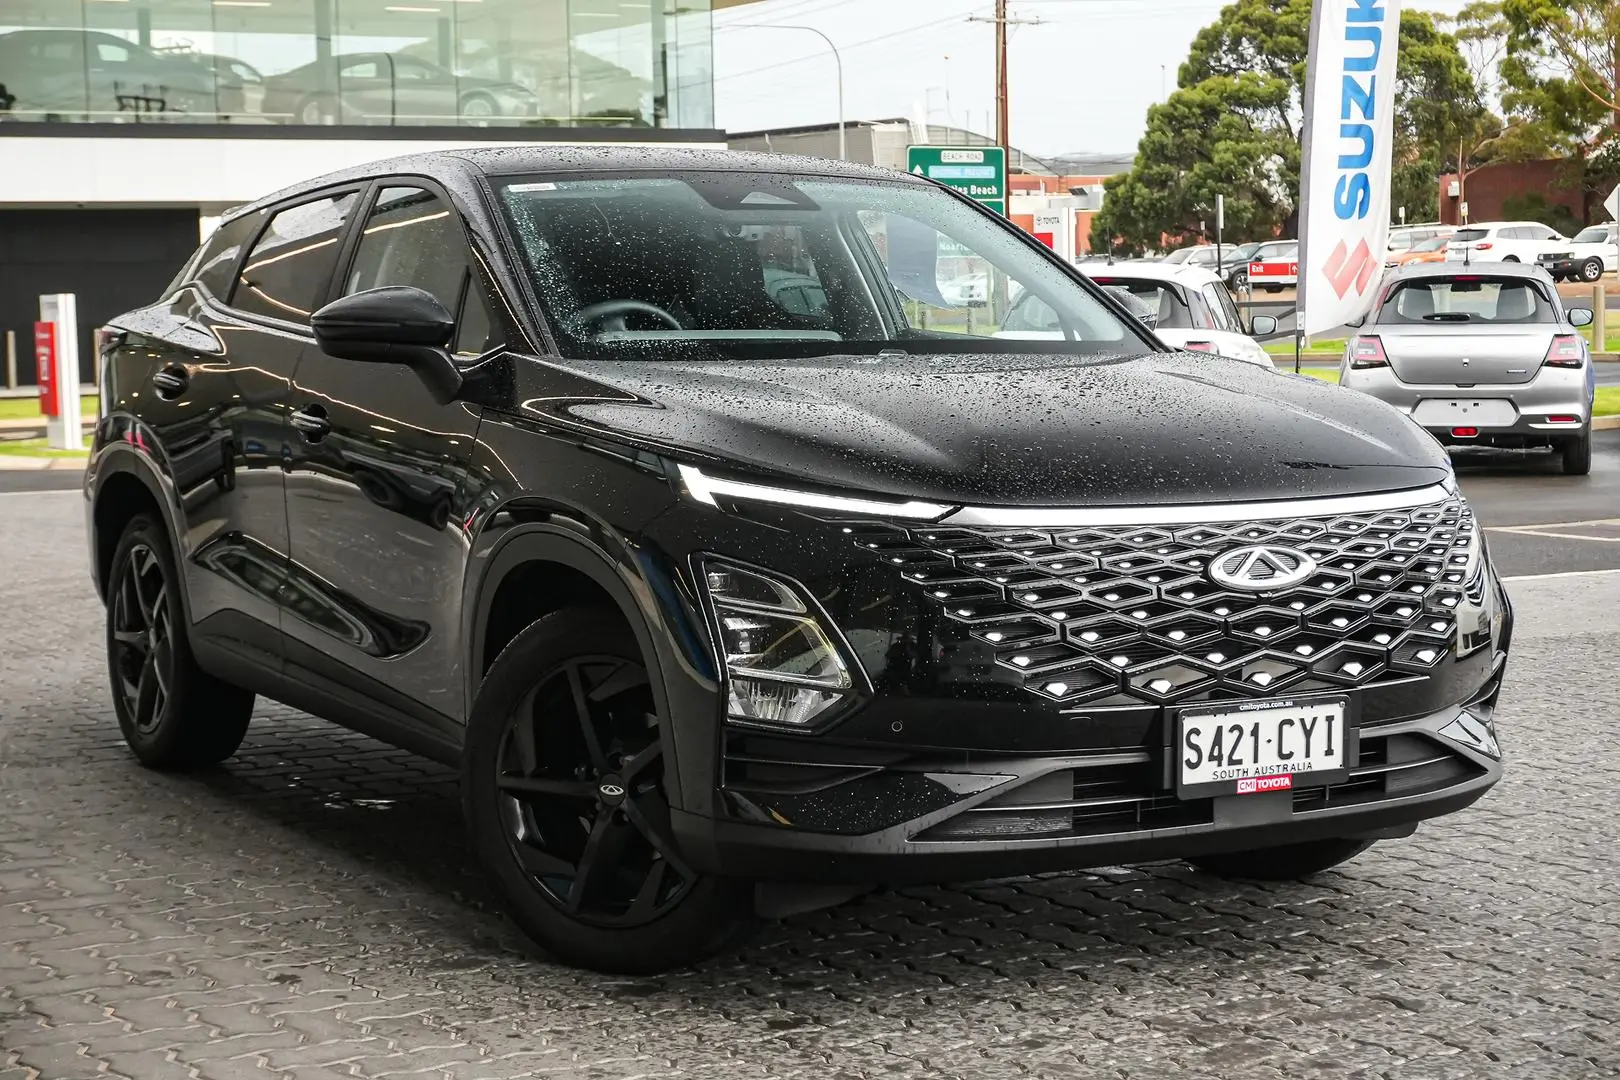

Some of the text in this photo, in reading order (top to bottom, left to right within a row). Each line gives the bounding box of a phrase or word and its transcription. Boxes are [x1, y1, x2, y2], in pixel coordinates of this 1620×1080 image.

[943, 152, 982, 161] BEACH ROAD
[970, 184, 998, 195] Beach
[1043, 216, 1060, 225] TOYOTA
[1251, 264, 1264, 273] Exit
[1239, 701, 1293, 711] cmitoyota.com.au
[1213, 761, 1313, 780] SOUTH AUSTRALIA
[1239, 776, 1291, 791] CMI TOYOTA
